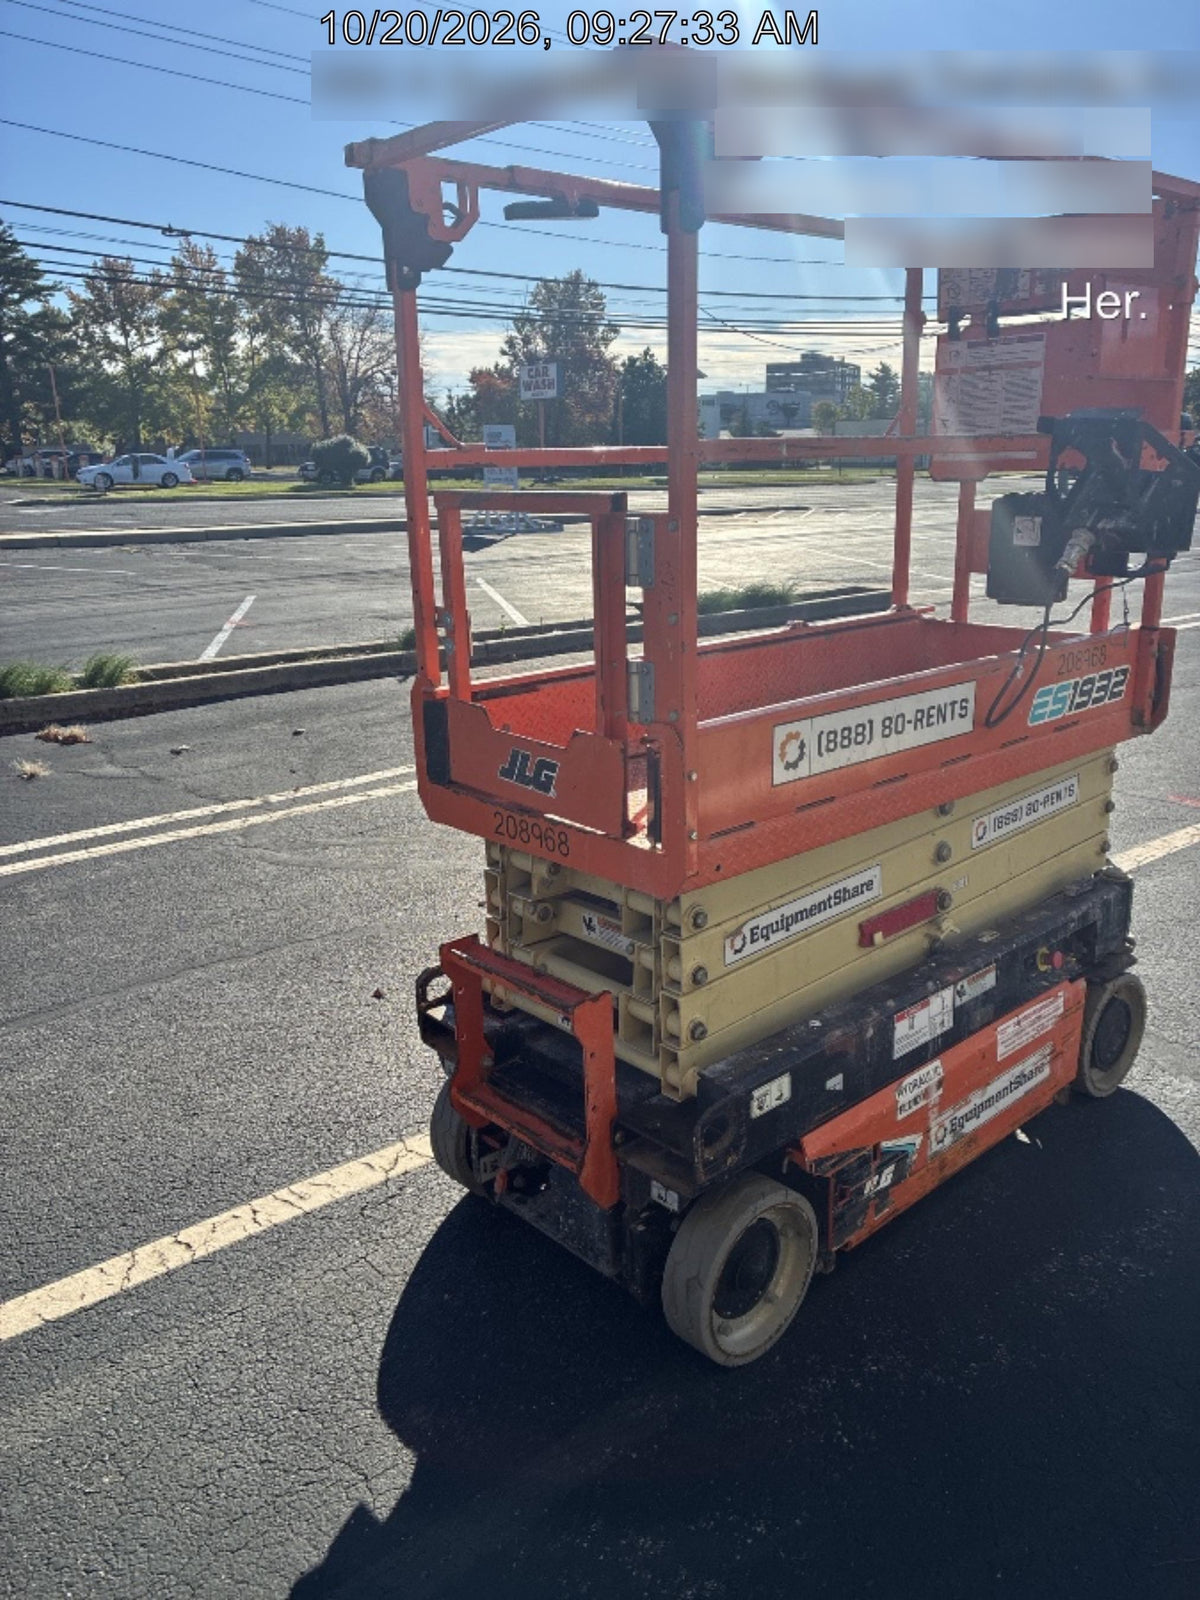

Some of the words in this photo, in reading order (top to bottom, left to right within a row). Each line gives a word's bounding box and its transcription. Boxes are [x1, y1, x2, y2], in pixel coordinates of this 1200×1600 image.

[522, 378, 555, 392] WASH
[527, 365, 550, 379] CAR
[1028, 664, 1131, 727] ES1932
[817, 718, 875, 758] (888)
[881, 697, 970, 739] 80-RENTS
[498, 746, 560, 798] JLG
[493, 811, 570, 857] 208968
[749, 878, 875, 945] EquipmentShare
